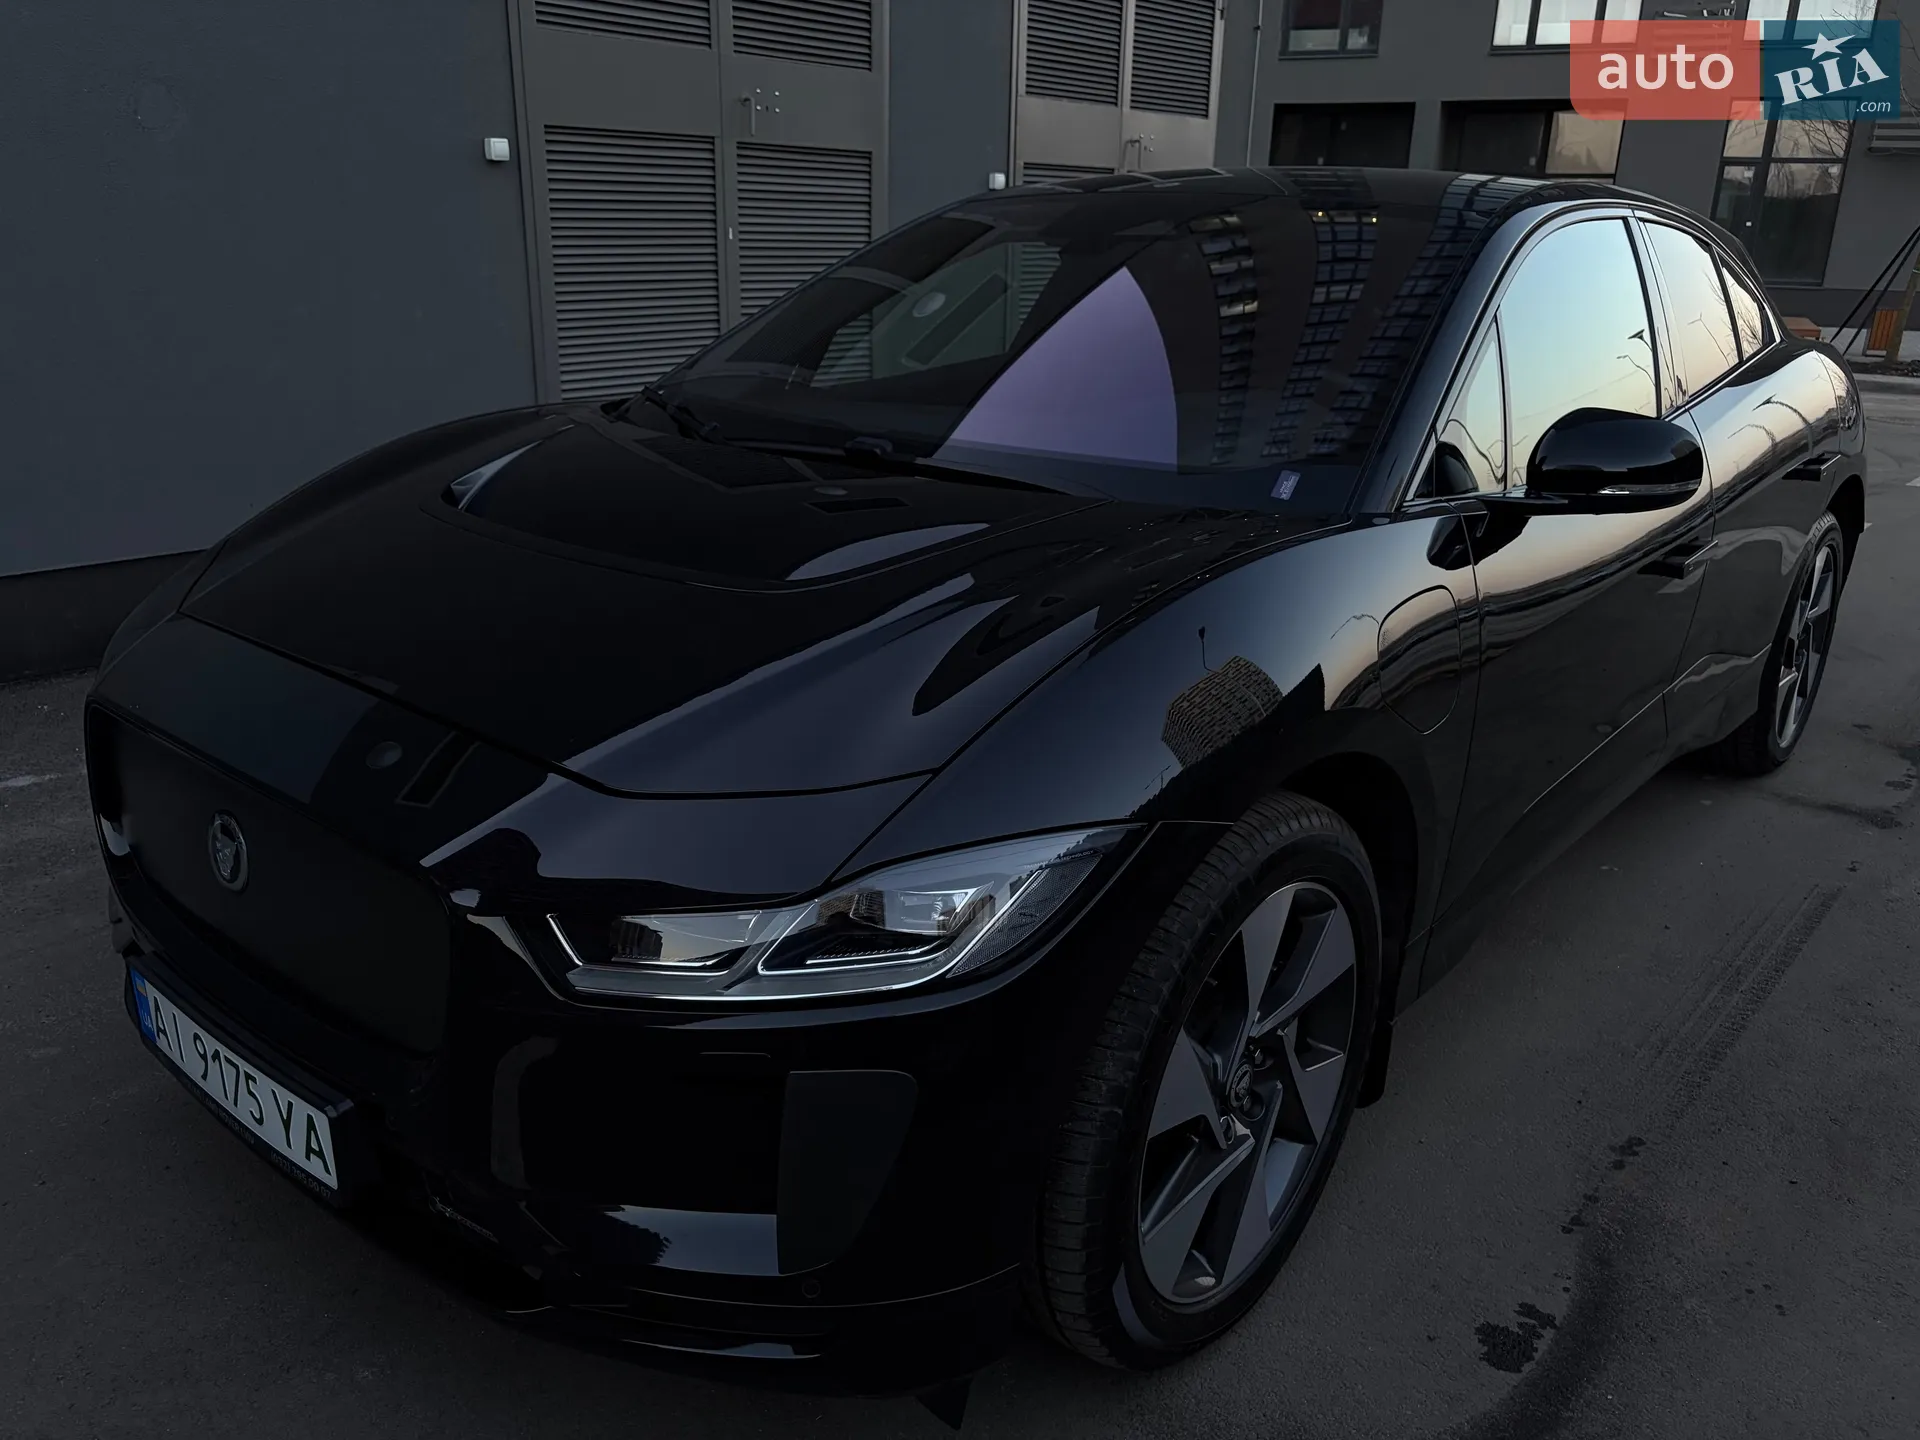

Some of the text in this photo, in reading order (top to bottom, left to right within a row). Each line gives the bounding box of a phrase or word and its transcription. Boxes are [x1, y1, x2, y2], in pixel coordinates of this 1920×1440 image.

[141, 1010, 154, 1031] UA
[153, 995, 332, 1176] AI 9175 YA
